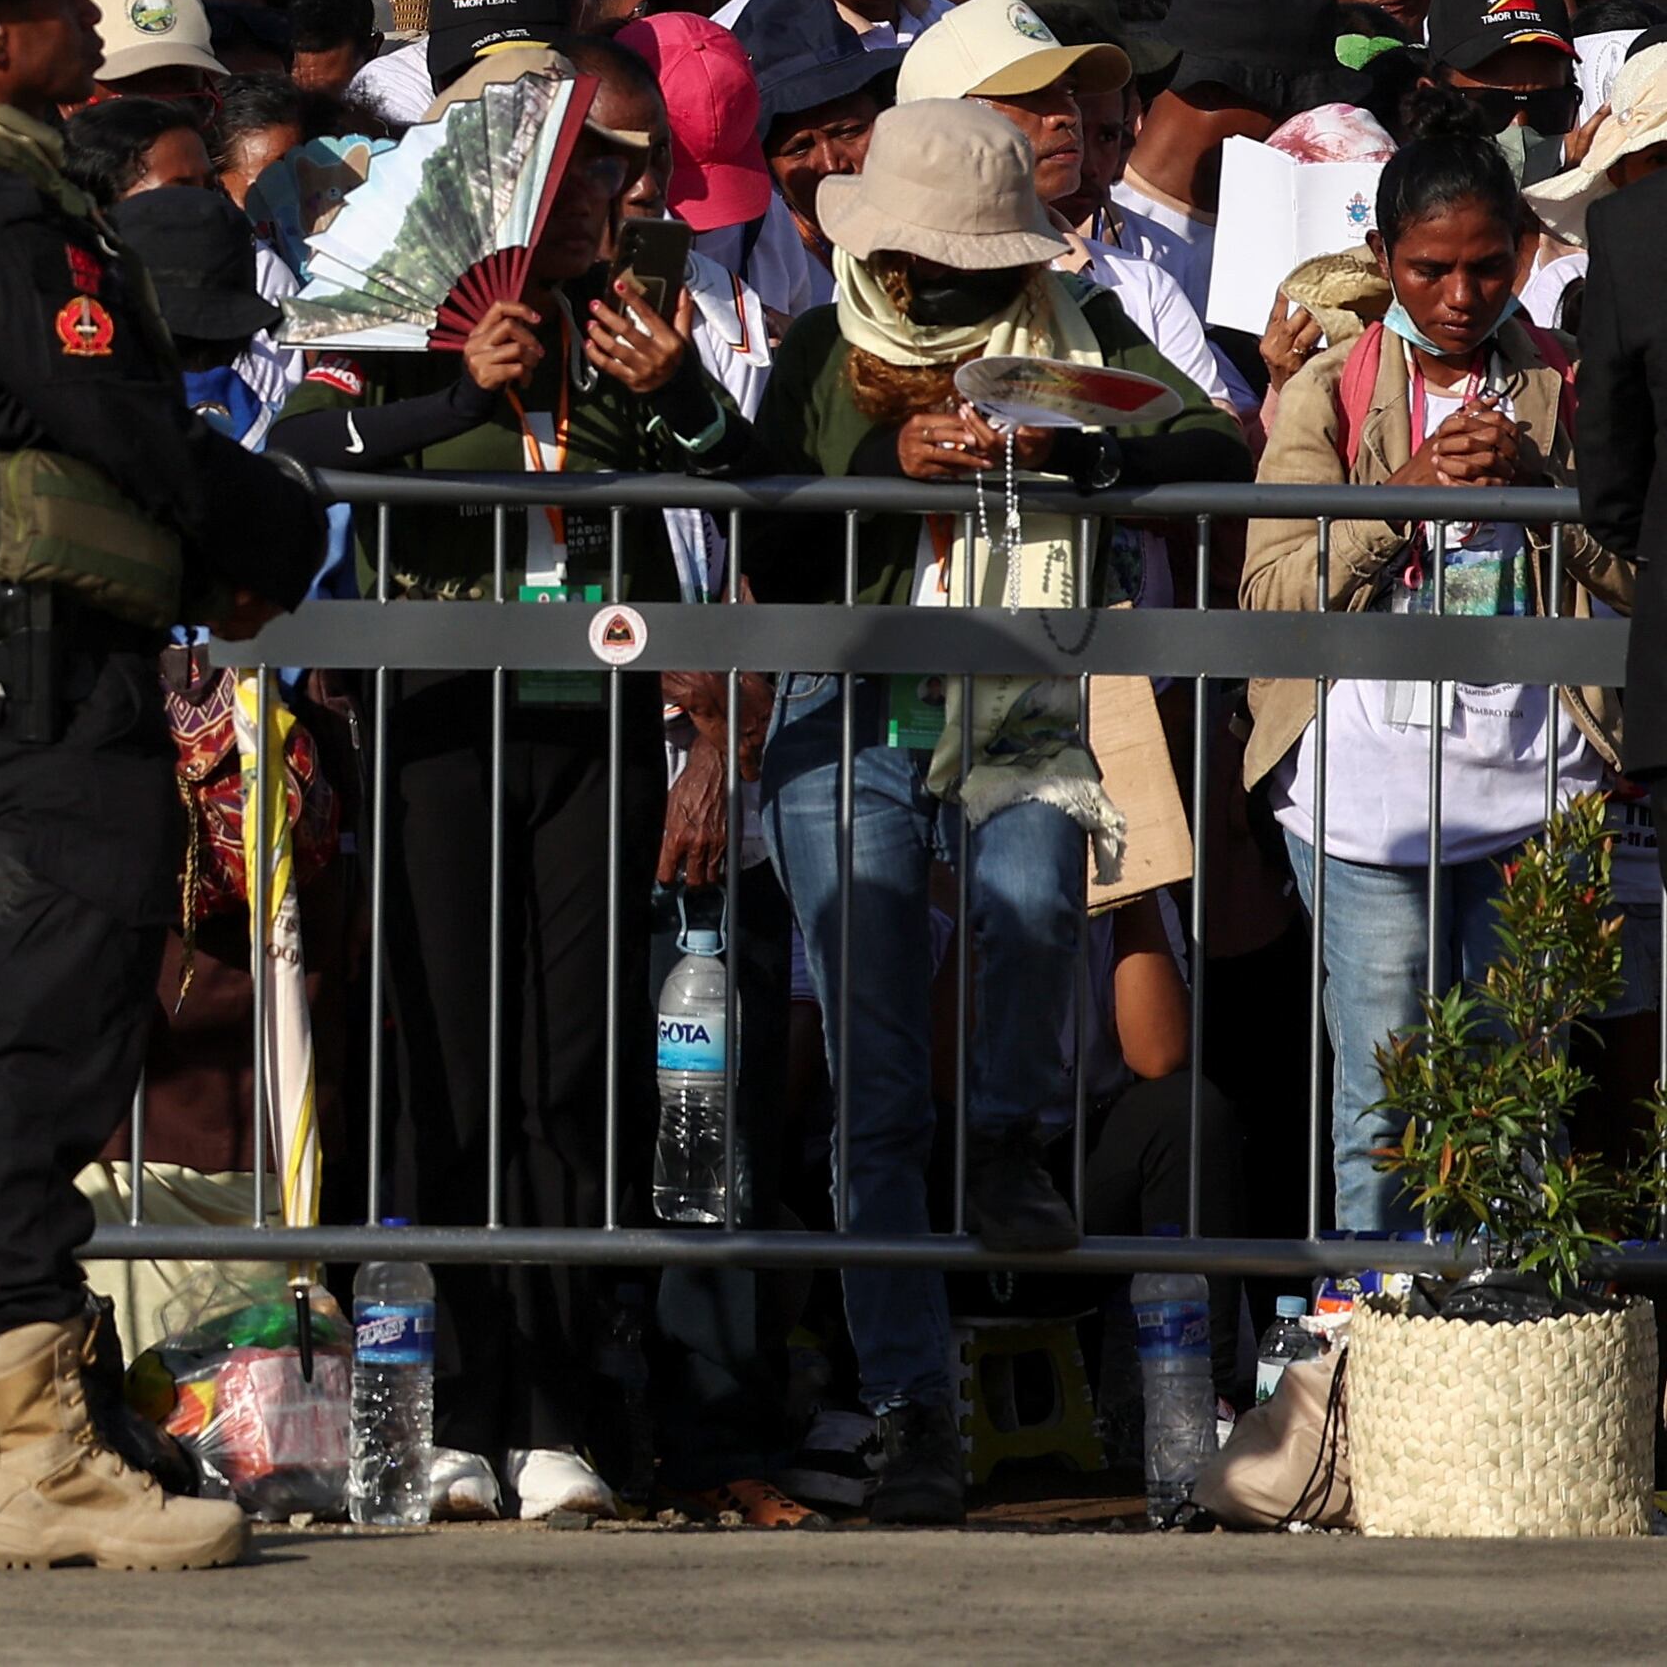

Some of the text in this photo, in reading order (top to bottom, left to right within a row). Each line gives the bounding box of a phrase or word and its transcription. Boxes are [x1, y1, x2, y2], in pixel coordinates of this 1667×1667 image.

[1480, 11, 1541, 26] TIMOR LESTE
[471, 32, 502, 49] TIMOR
[658, 1021, 711, 1046] GOTA
